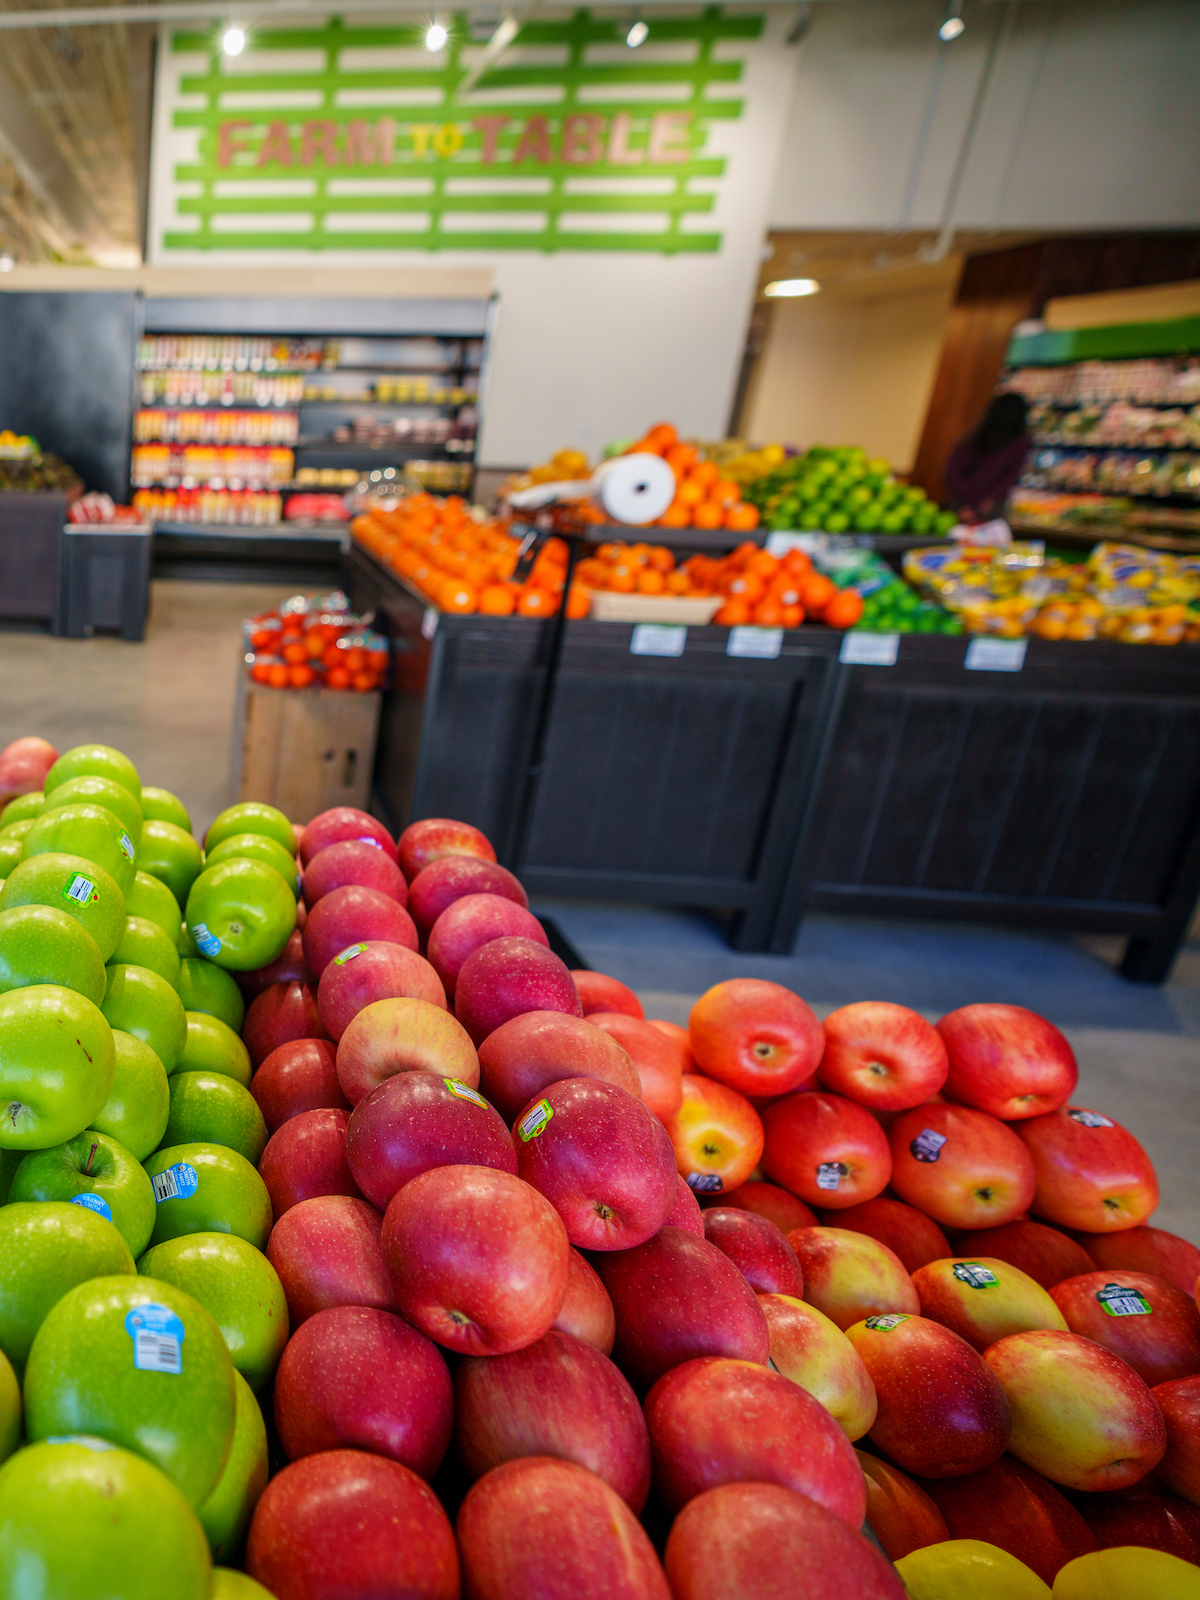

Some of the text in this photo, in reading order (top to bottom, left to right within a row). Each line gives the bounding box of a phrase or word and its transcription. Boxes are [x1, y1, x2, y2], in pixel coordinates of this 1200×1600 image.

[215, 111, 695, 169] FARM TO TABLE
[187, 1167, 197, 1187] GRANNY
[82, 1195, 105, 1208] GRANNY
[84, 1200, 101, 1212] SMITH
